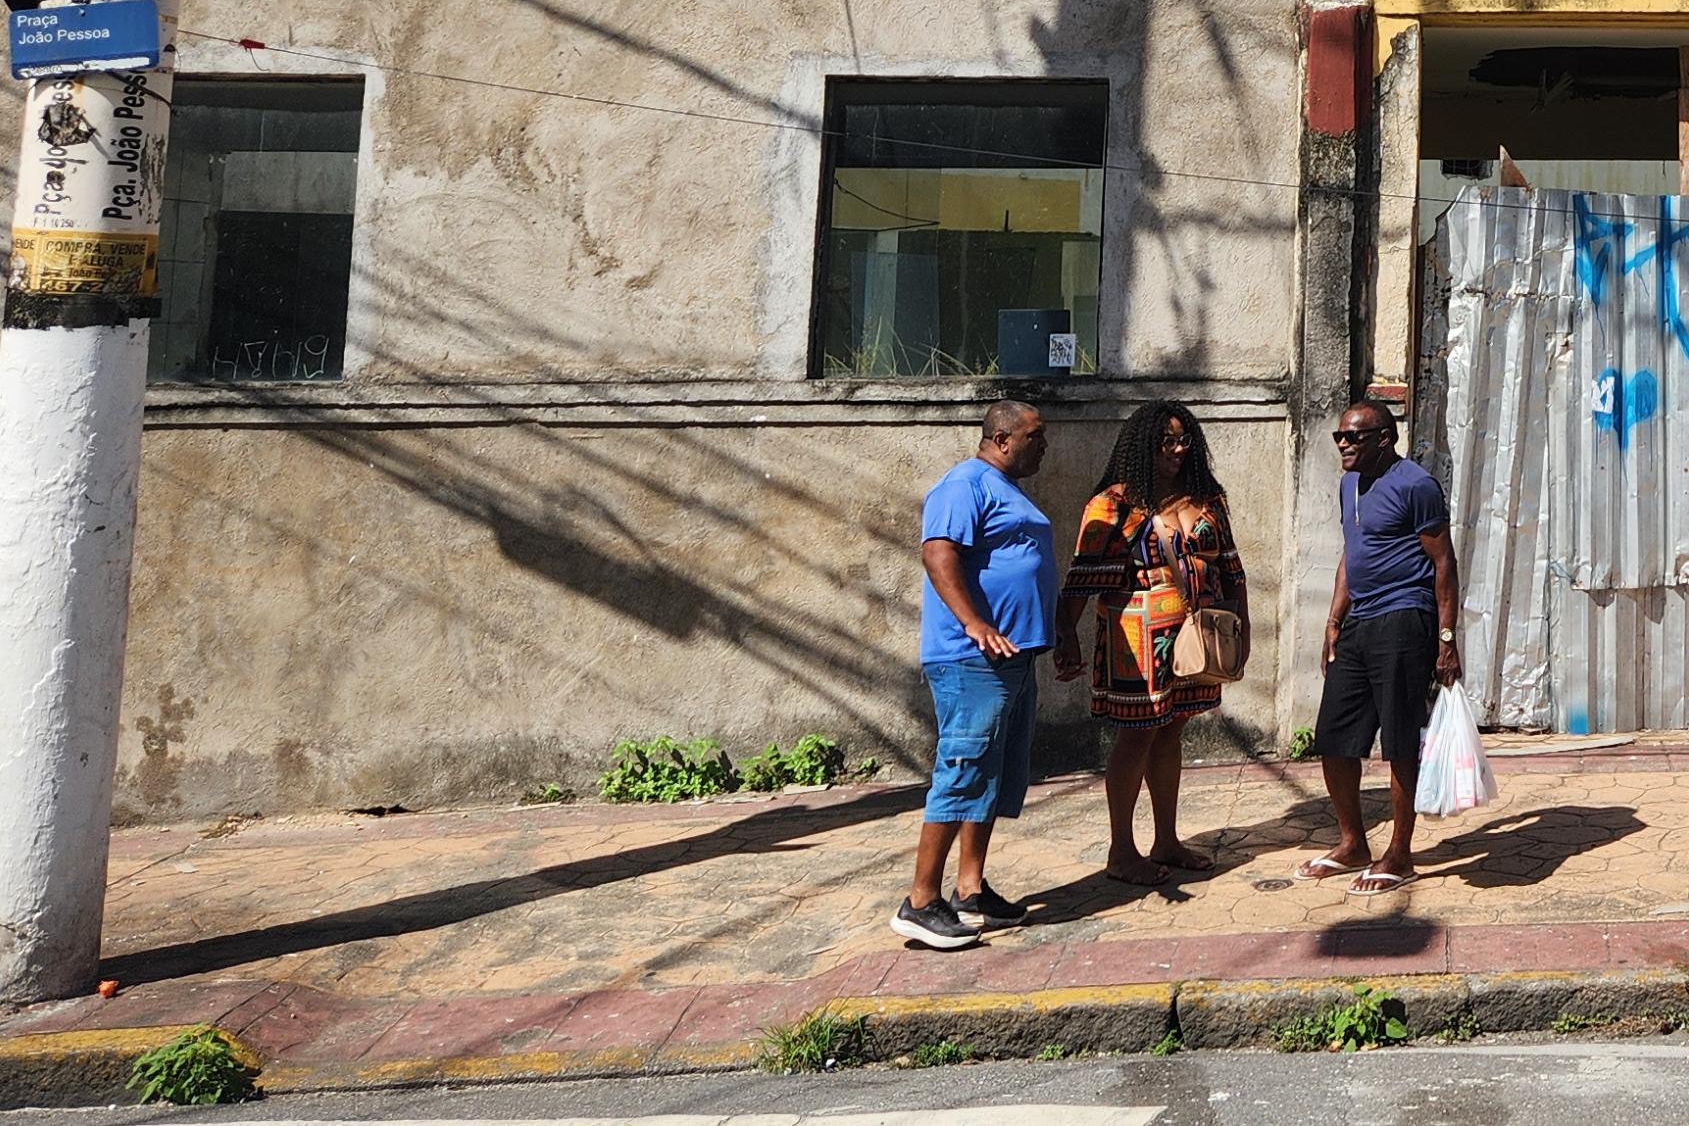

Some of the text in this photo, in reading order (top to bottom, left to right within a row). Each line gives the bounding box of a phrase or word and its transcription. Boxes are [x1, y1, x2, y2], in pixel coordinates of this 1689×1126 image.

[17, 14, 58, 28] Praça
[18, 28, 110, 45] João Pessoa
[107, 126, 143, 172] João
[101, 179, 140, 221] Pça.
[110, 243, 146, 255] VENDE
[79, 254, 125, 267] ALUGA
